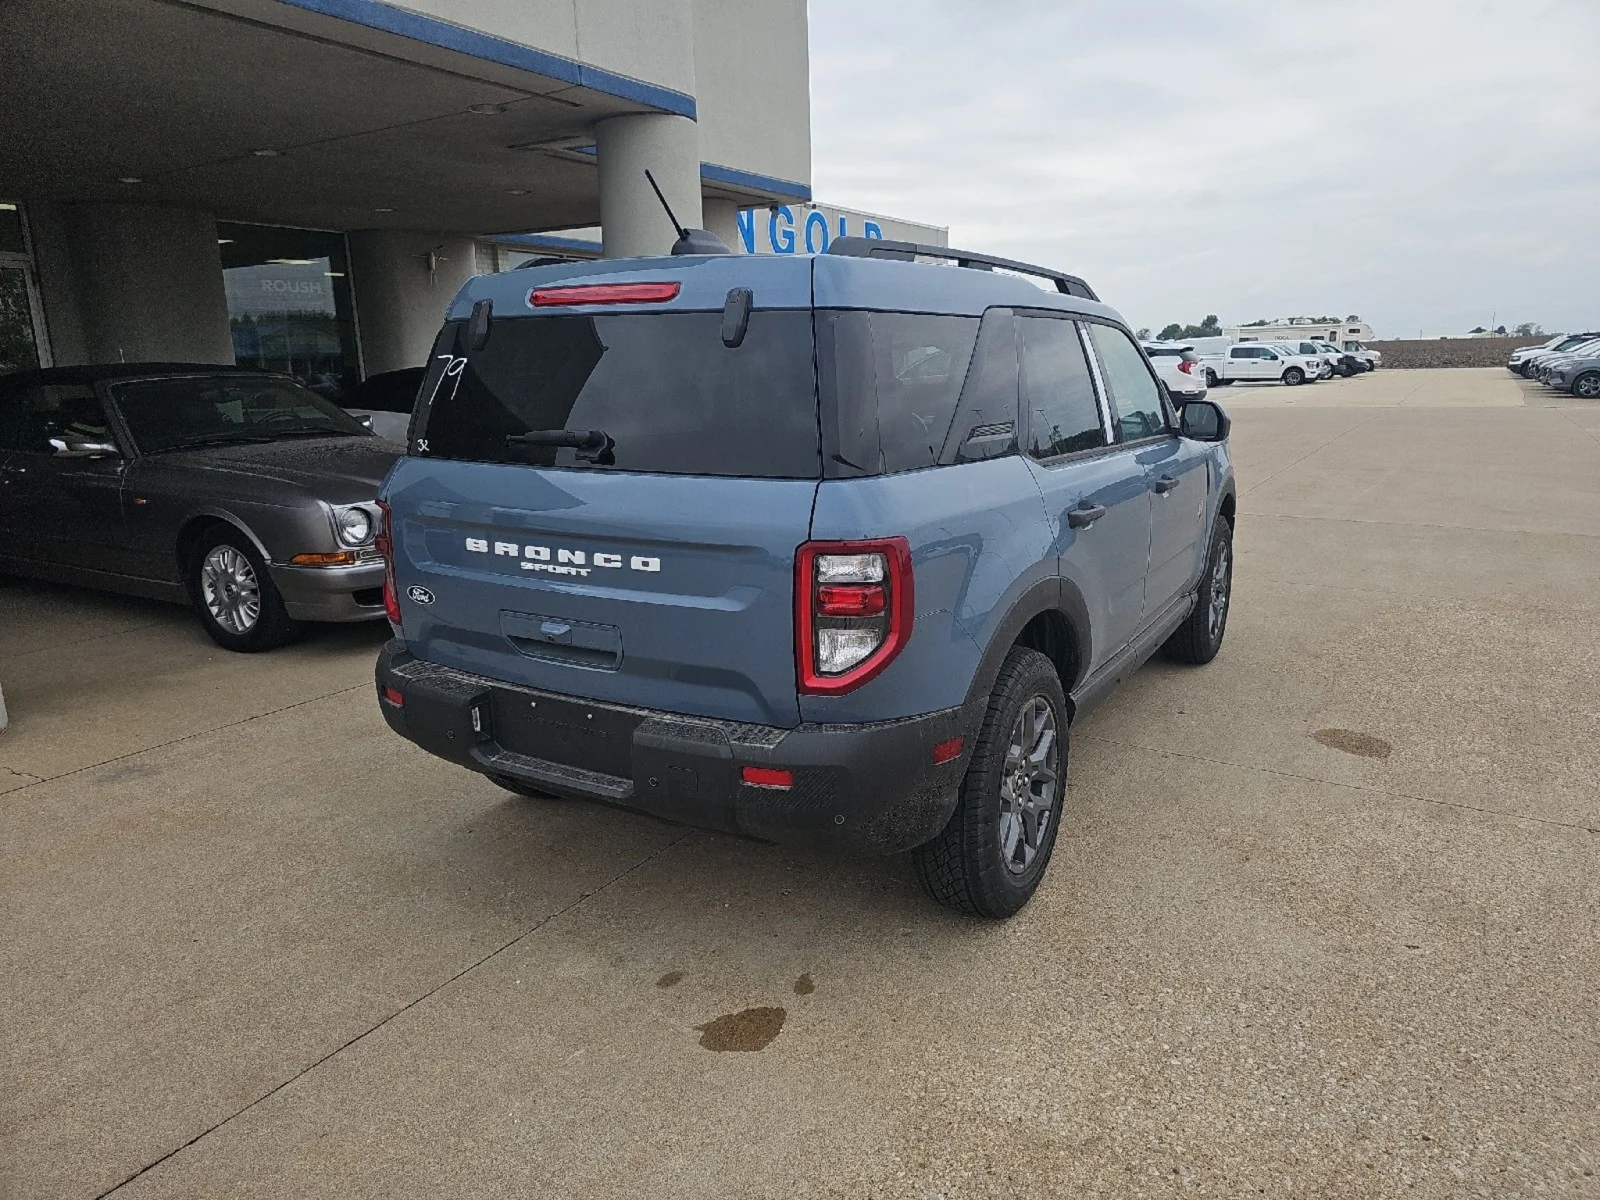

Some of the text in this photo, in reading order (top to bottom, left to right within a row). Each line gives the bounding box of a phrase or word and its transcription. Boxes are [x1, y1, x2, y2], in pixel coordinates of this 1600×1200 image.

[261, 279, 324, 294] ROUSH
[428, 354, 468, 405] 79
[465, 537, 661, 572] BRONCO
[520, 561, 592, 577] SPORT
